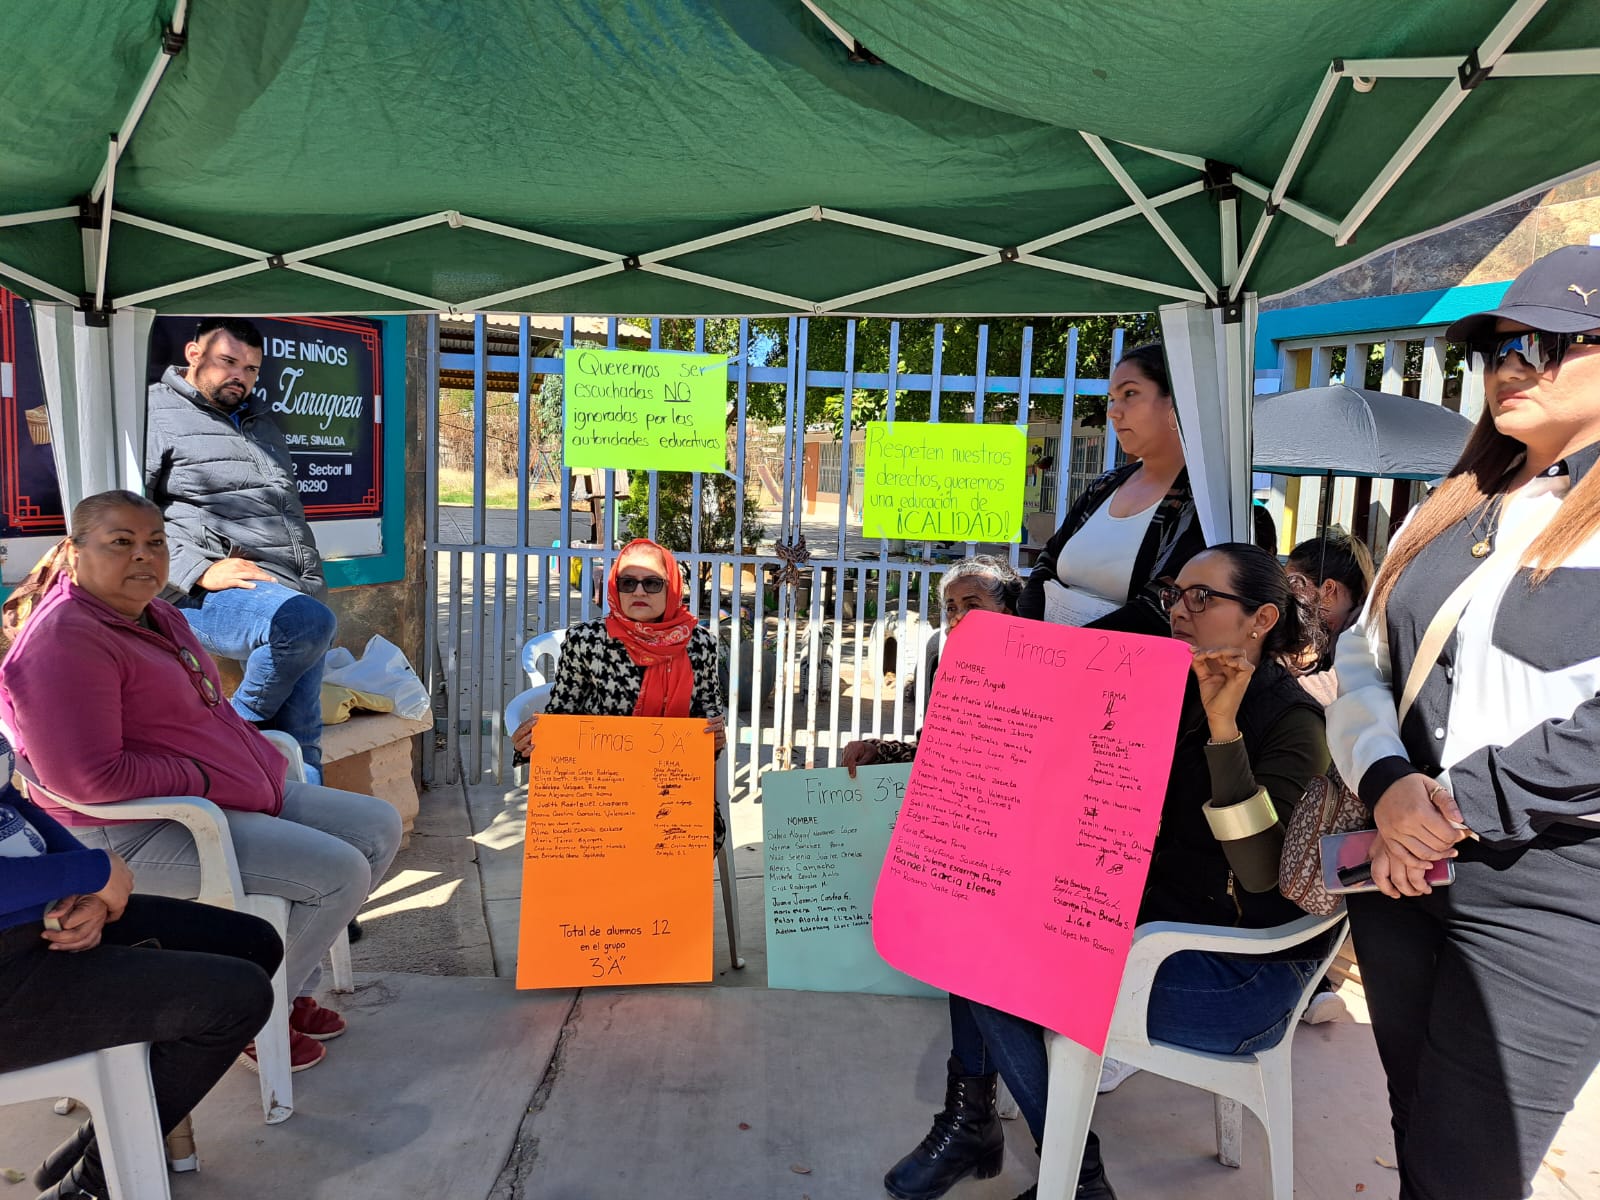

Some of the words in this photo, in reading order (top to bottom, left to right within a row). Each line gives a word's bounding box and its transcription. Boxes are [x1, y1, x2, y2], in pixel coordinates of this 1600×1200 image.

[272, 339, 296, 359] DE
[300, 339, 348, 366] NIÑOS
[578, 352, 659, 378] Queremos
[272, 367, 363, 430] Zaragoza
[574, 381, 653, 400] escuchadas
[664, 382, 691, 402] NO
[574, 405, 638, 430] ignoradas
[646, 414, 667, 430] por
[671, 408, 693, 426] las
[283, 434, 309, 446] SAVE,
[311, 436, 345, 446] SINALOA
[572, 430, 649, 446] autoridades
[659, 431, 720, 449] educativas
[869, 426, 943, 469] Respeten
[952, 442, 1011, 466] nuestros
[309, 463, 342, 476] Sector
[944, 477, 1004, 495] queremos
[871, 494, 893, 508] una
[900, 490, 957, 510] educación
[971, 494, 988, 512] de
[897, 508, 1010, 540] ¡CALIDAD!
[1004, 624, 1067, 668] Firmas
[1086, 635, 1109, 672] 2
[1114, 645, 1146, 677] "A"
[955, 661, 986, 675] NOMBRE
[960, 675, 980, 687] Flores
[952, 693, 959, 701] de
[578, 720, 633, 752] Firmas
[648, 722, 664, 753] 3
[672, 730, 692, 753] "A"
[805, 778, 862, 804] Firmas
[873, 777, 889, 802] 3
[787, 817, 818, 826] NOMBRE
[952, 821, 969, 833] Valle
[795, 862, 836, 871] Camacho
[820, 892, 842, 902] Castro
[966, 882, 996, 896] Elenes
[560, 924, 586, 938] Total
[589, 926, 600, 936] de
[606, 924, 642, 937] alumnos
[652, 919, 671, 936] 12
[580, 944, 590, 952] en
[593, 942, 600, 951] el
[604, 941, 626, 954] grupo
[589, 957, 605, 978] 3
[607, 955, 627, 976] "A"
